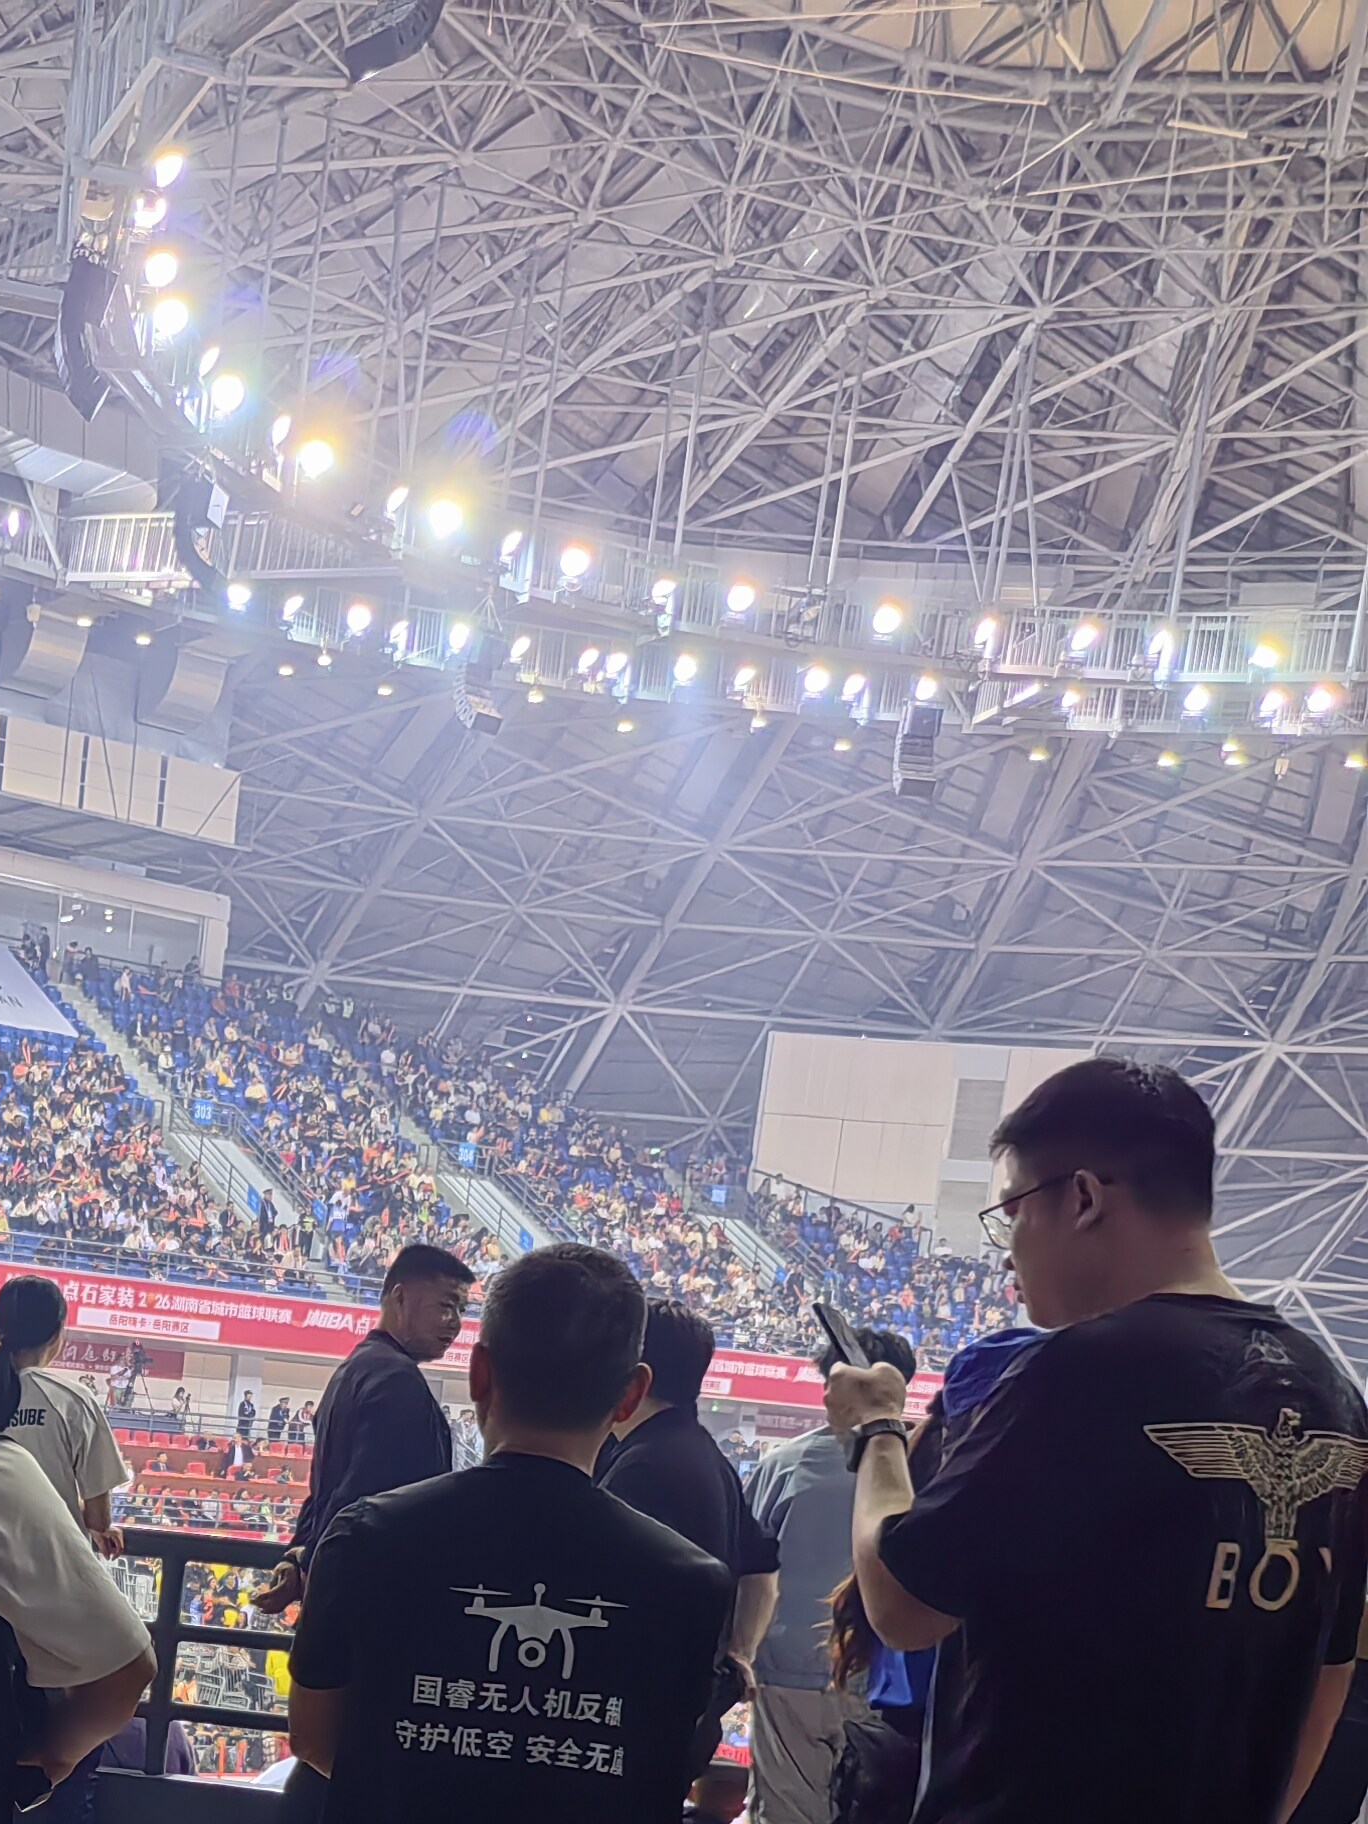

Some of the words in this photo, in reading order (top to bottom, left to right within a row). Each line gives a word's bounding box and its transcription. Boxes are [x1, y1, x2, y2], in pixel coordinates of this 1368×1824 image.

[62, 1280, 135, 1308] 点石家装
[395, 1719, 515, 1760] 守护低空
